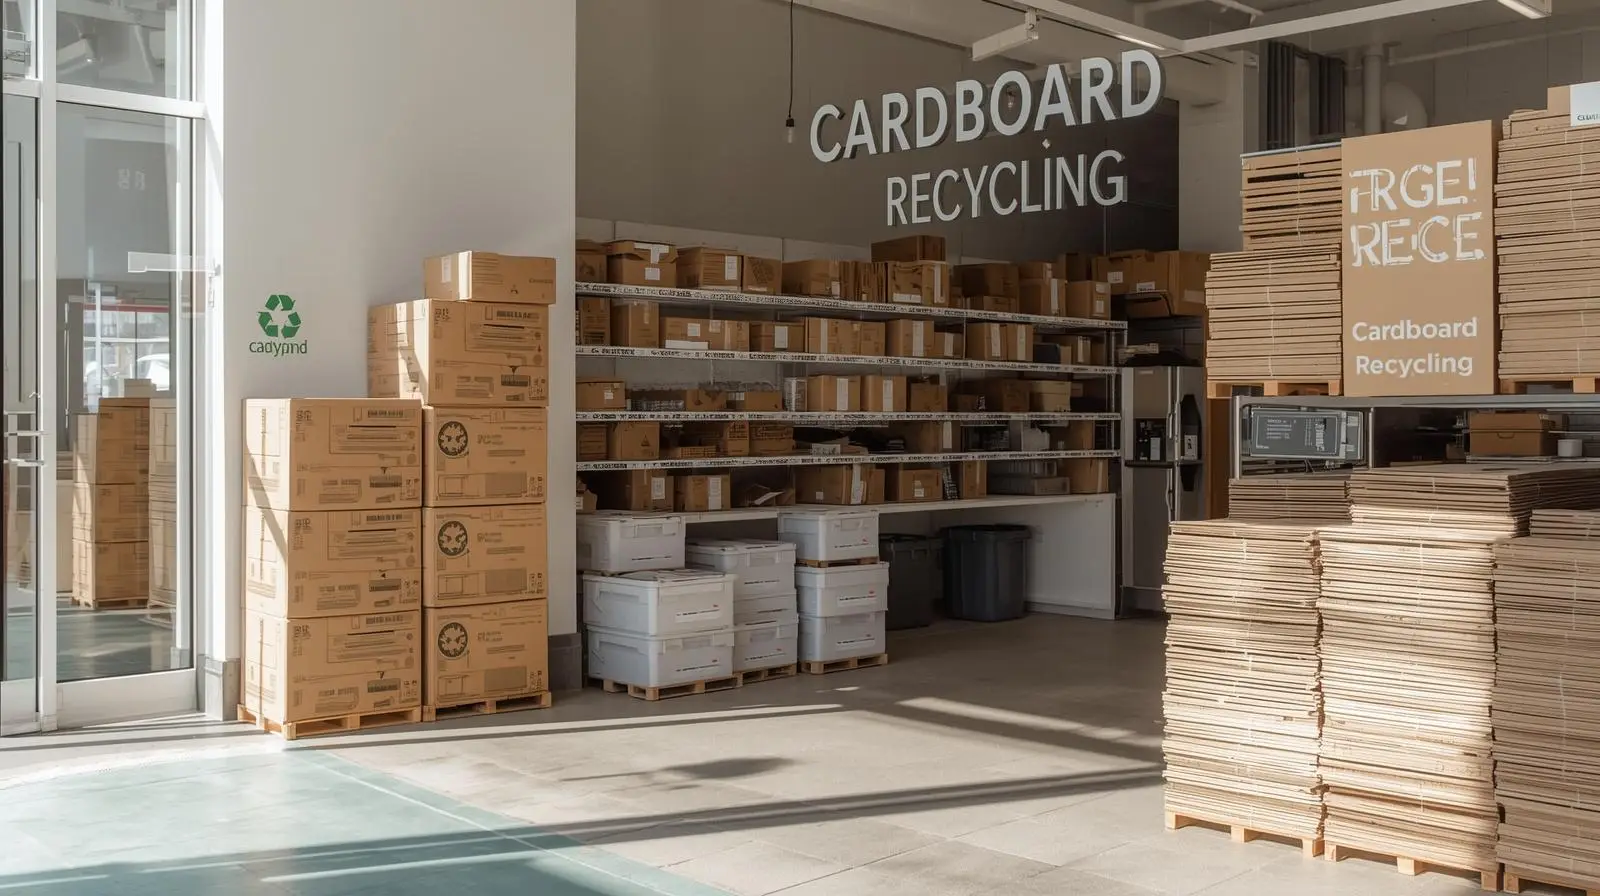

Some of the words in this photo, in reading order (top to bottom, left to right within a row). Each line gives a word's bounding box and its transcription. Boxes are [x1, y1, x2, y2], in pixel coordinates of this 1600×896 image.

[809, 49, 1163, 163] CARDBOARD
[886, 149, 1129, 226] RECYCLING
[1351, 316, 1478, 342] Cardboard
[1355, 352, 1474, 378] Recycling
